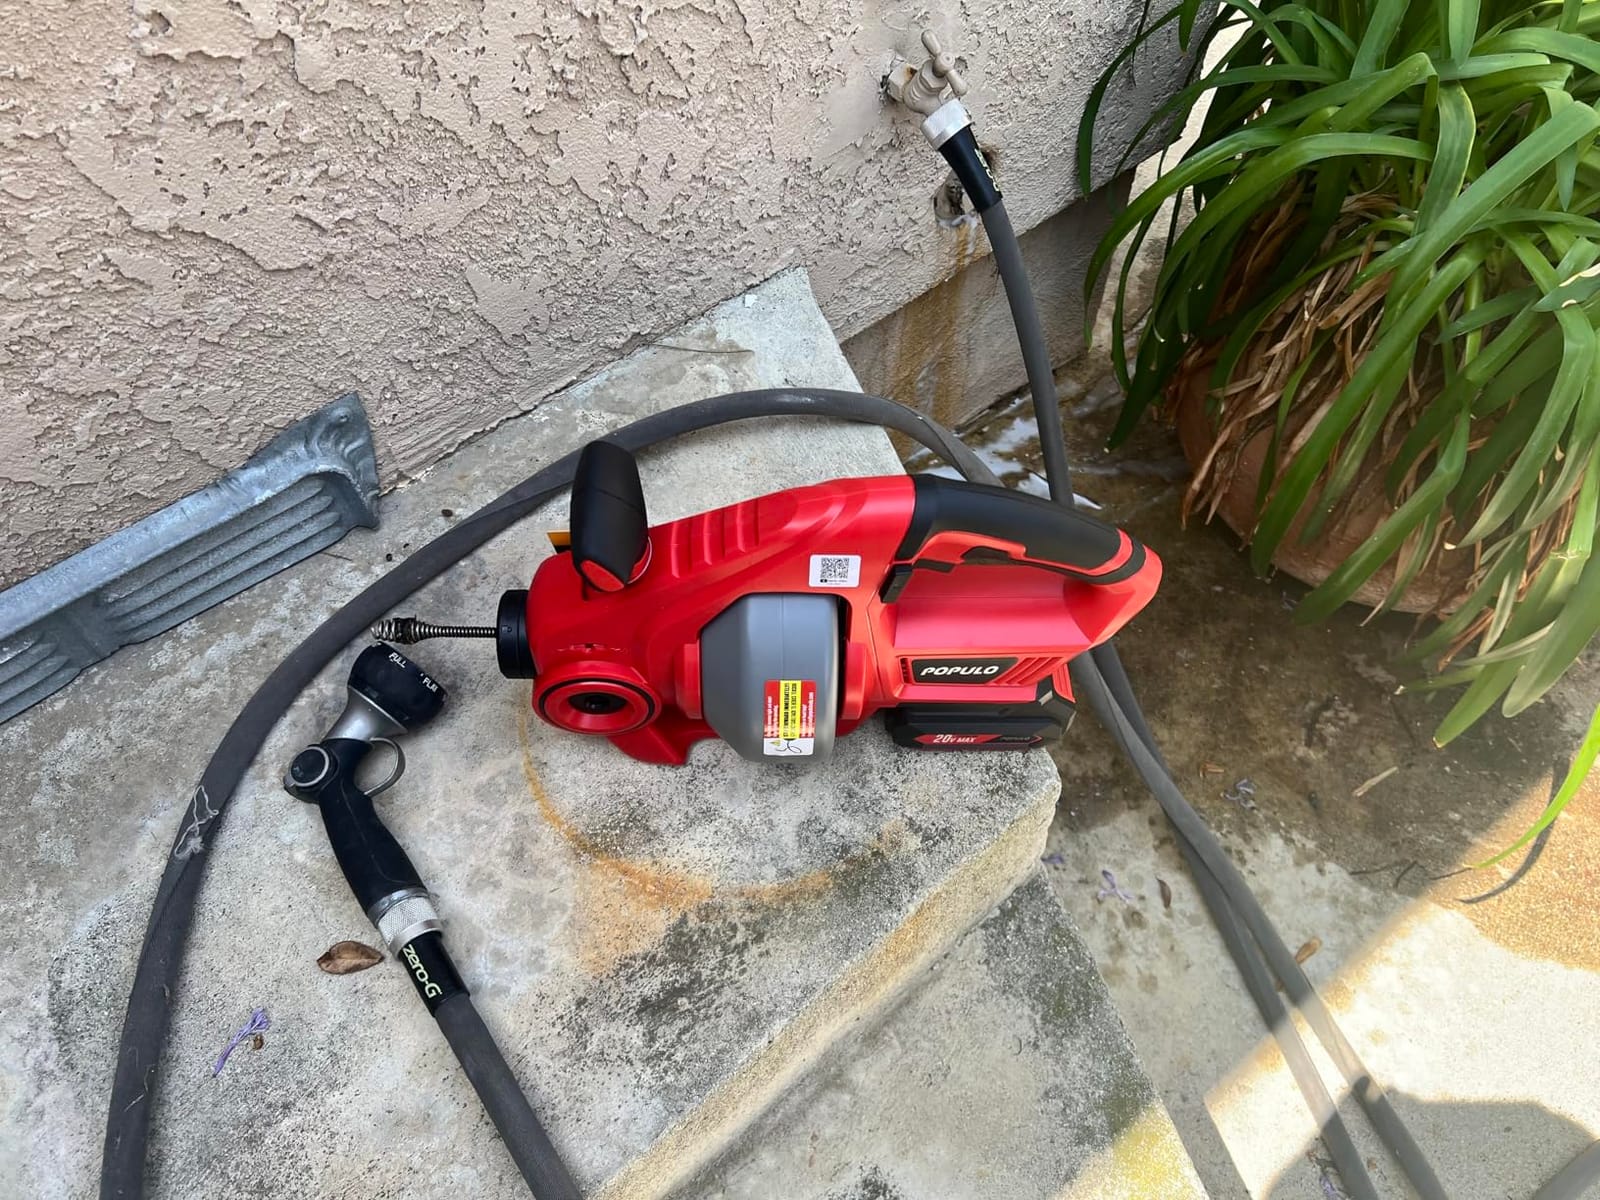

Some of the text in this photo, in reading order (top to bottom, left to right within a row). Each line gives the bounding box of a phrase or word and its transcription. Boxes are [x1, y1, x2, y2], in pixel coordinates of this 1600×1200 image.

[388, 652, 408, 669] FULL
[920, 665, 999, 676] POPULO
[402, 944, 442, 999] zero-G
